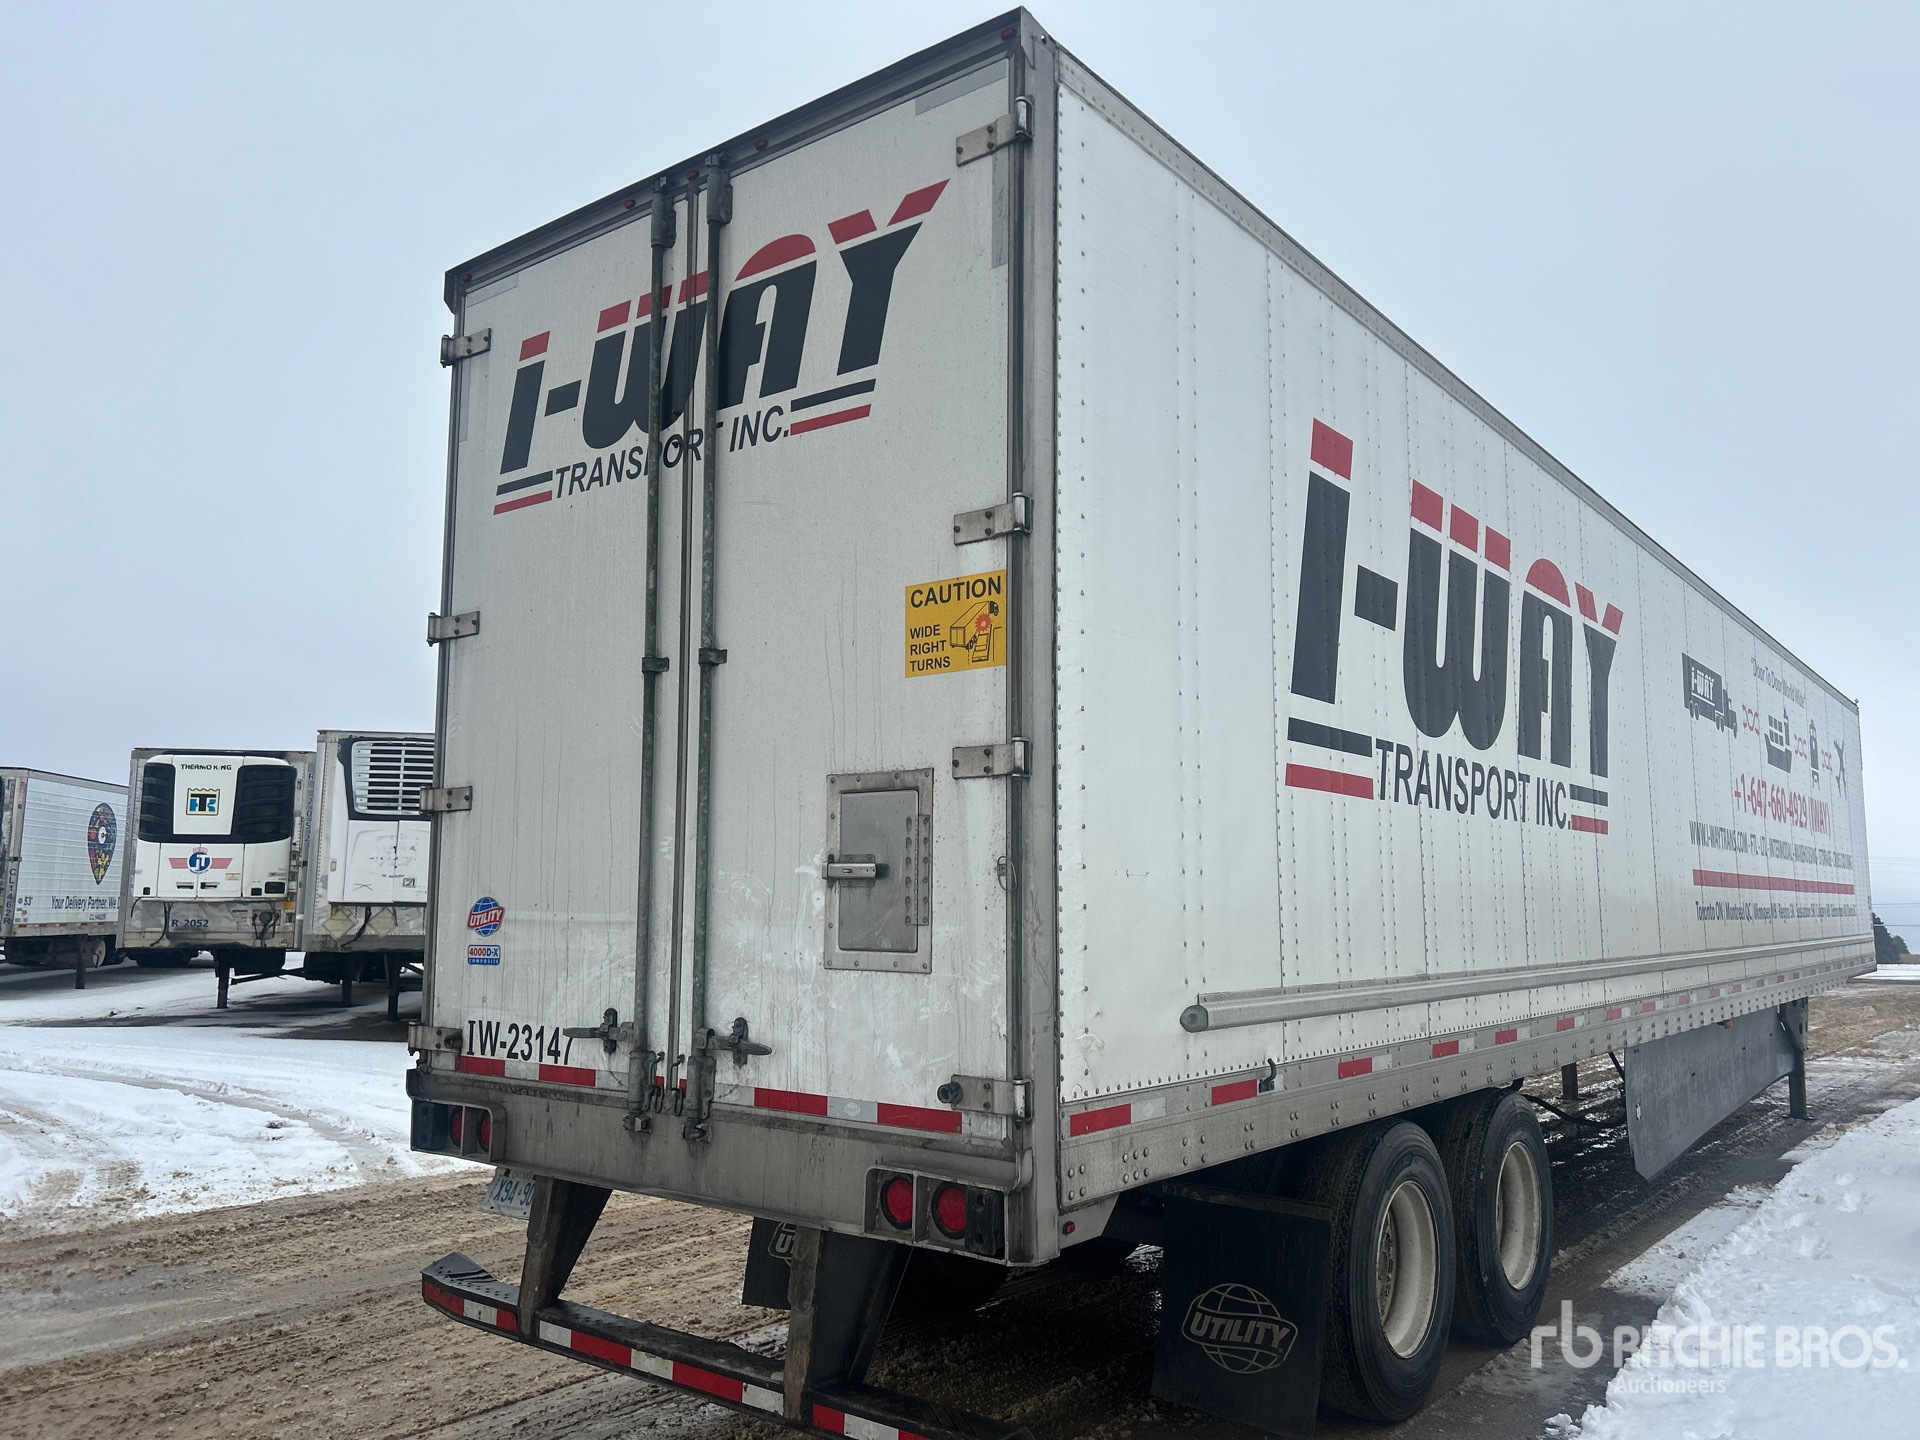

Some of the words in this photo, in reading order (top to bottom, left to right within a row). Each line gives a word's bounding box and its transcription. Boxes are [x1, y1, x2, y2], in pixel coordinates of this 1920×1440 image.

[729, 405, 790, 453] INC.
[910, 575, 1001, 608] CAUTION
[909, 624, 941, 640] WIDE
[909, 640, 947, 656] RIGHT
[909, 656, 951, 672] TURNS
[1376, 738, 1531, 823] TRANSPORT
[1536, 777, 1572, 830] INC.
[51, 895, 65, 909] Your
[65, 895, 87, 911] Delivery
[470, 910, 503, 927] UTILITY
[1190, 1311, 1291, 1349] UTILITY
